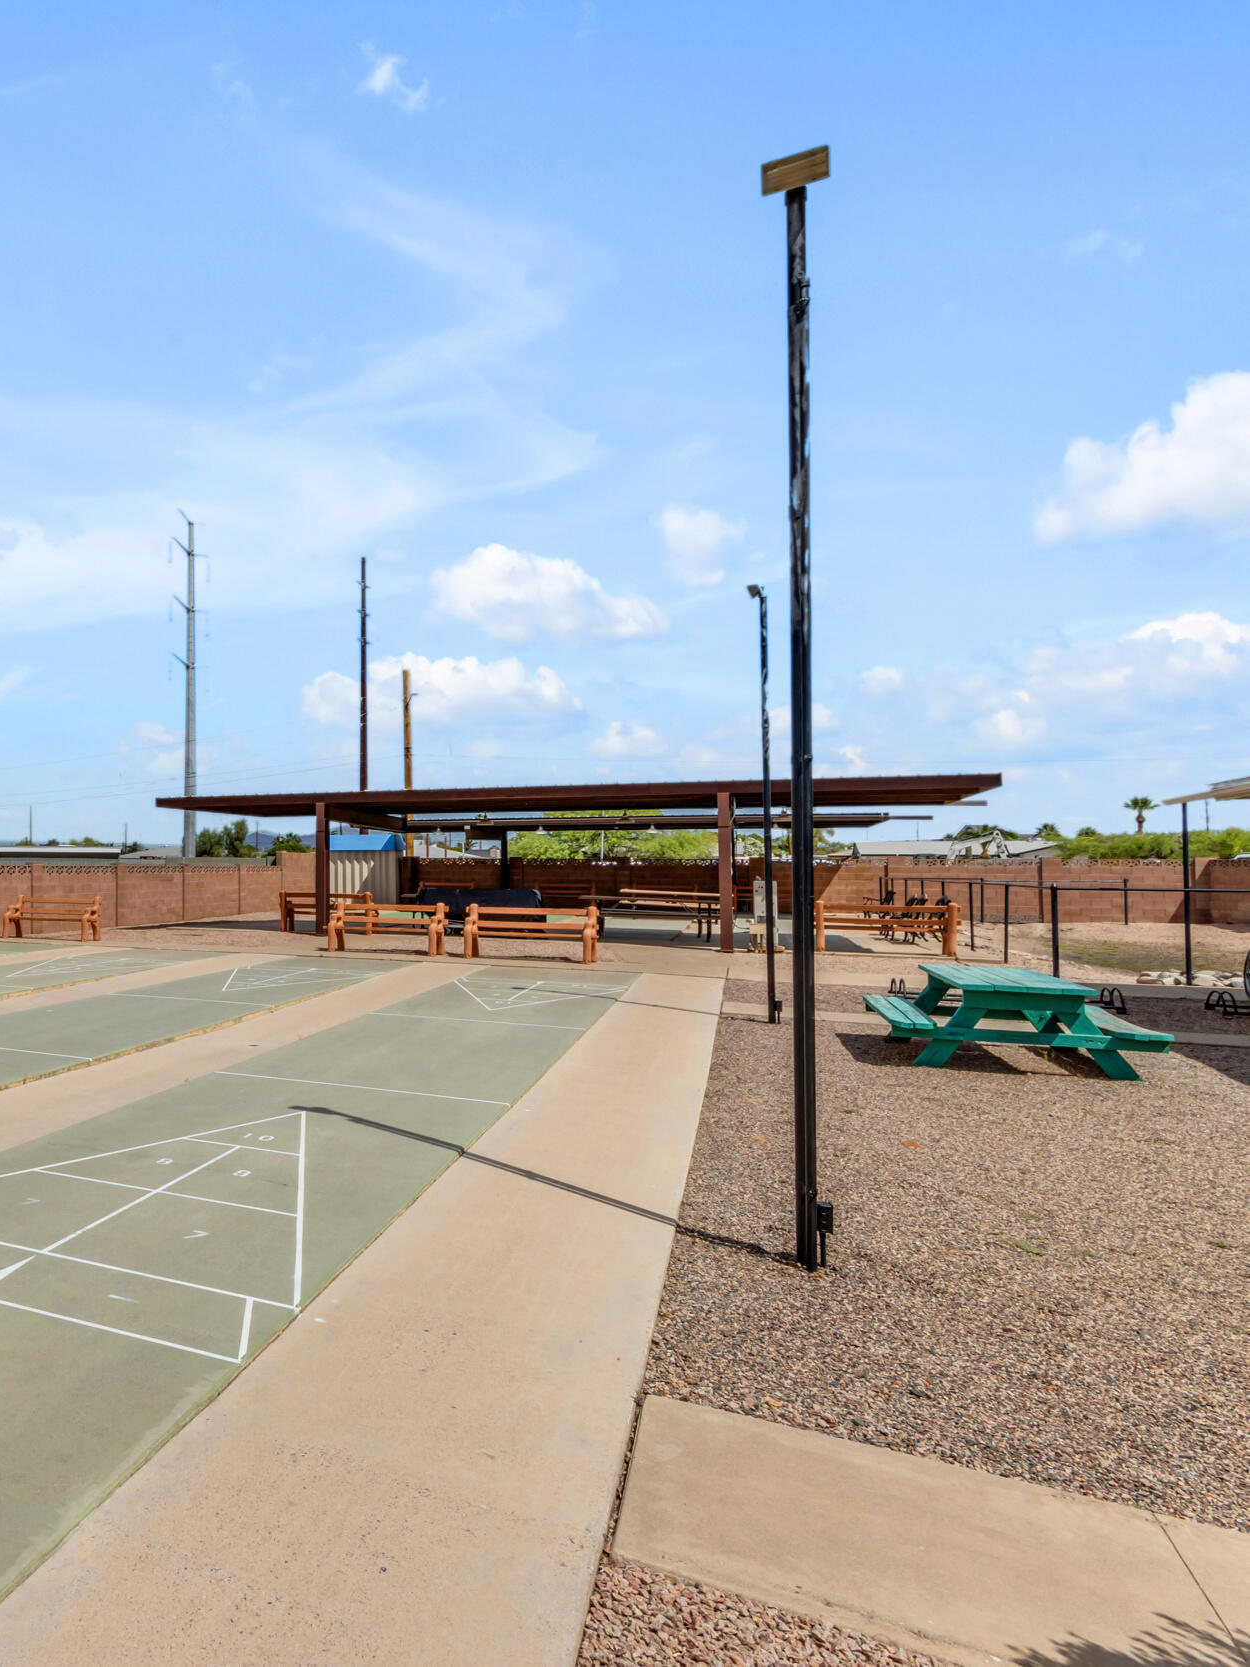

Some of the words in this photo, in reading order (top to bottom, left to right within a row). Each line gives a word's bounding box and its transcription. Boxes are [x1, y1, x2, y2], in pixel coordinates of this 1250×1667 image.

[243, 1132, 274, 1141] 10
[156, 1157, 173, 1165] 8
[232, 1169, 251, 1177] 8
[14, 1197, 40, 1205] 7
[182, 1229, 210, 1239] 7
